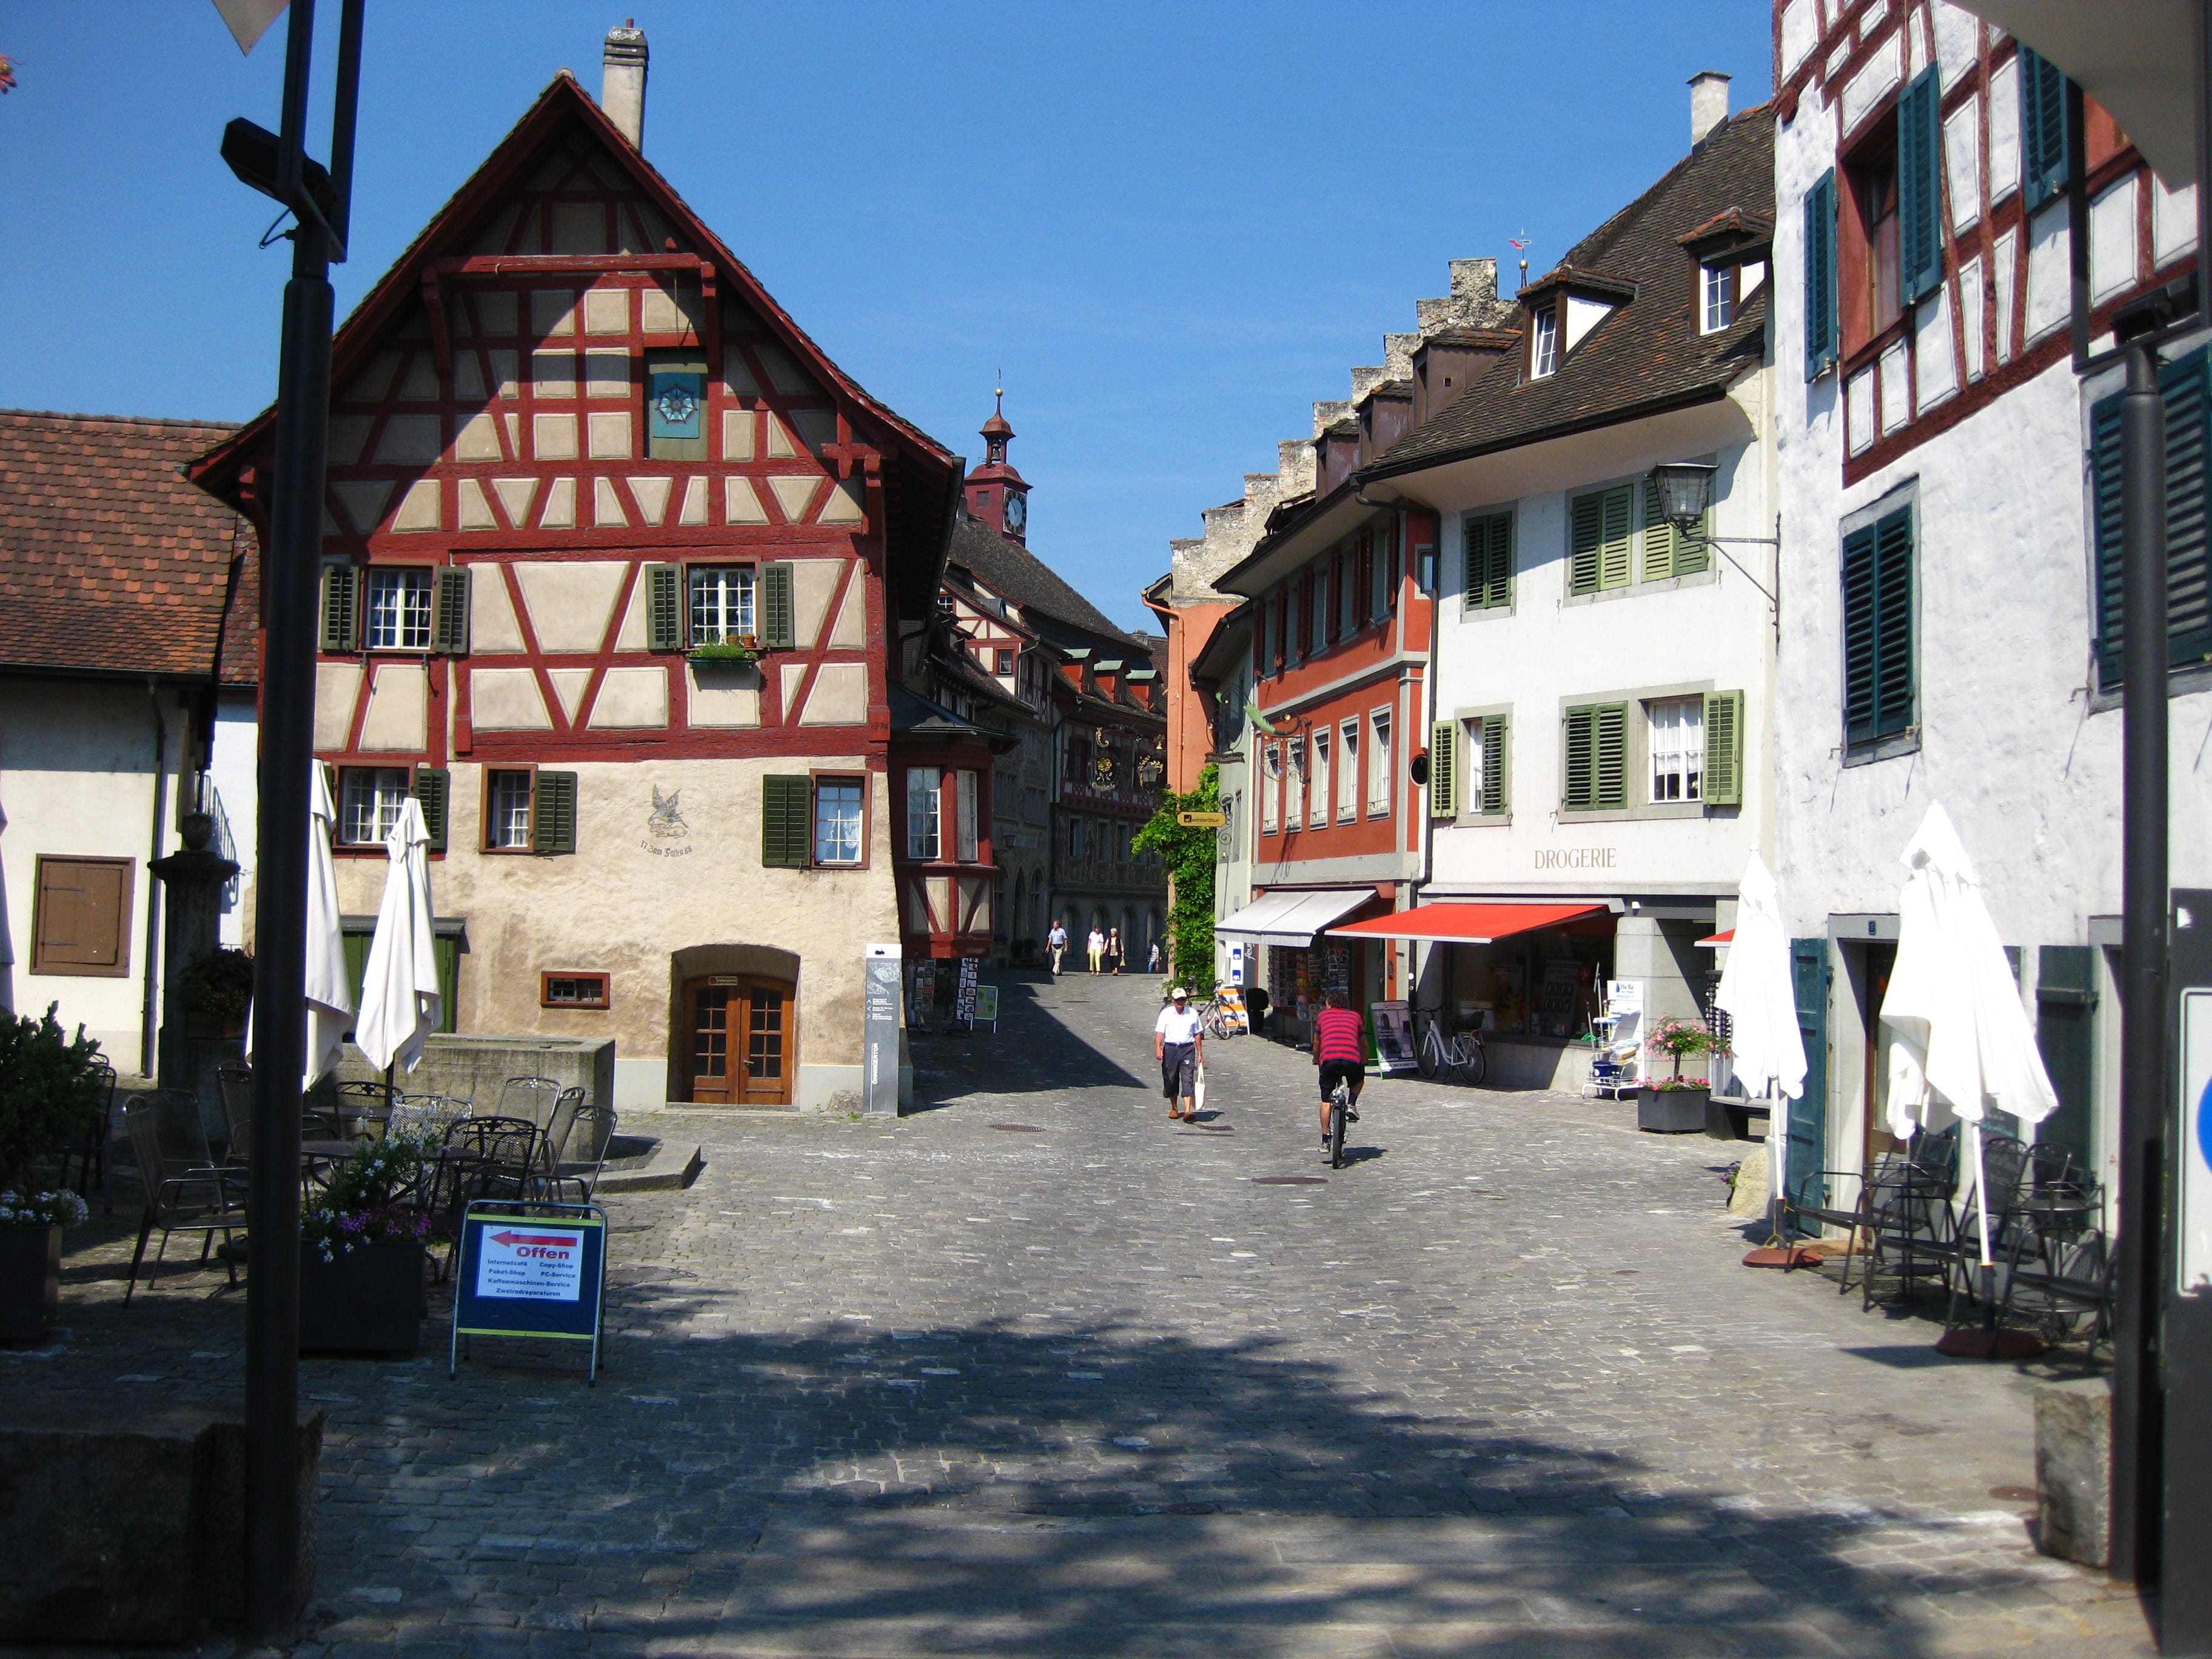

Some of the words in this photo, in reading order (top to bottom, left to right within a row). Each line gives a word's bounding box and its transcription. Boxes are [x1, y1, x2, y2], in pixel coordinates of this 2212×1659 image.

[685, 845, 692, 855] 88
[1535, 848, 1616, 869] DROGERIE
[517, 1246, 570, 1259] Offen
[488, 1278, 571, 1287] Kaffeemaschinen-Service
[495, 1288, 561, 1296] Zweiradreparaturen
